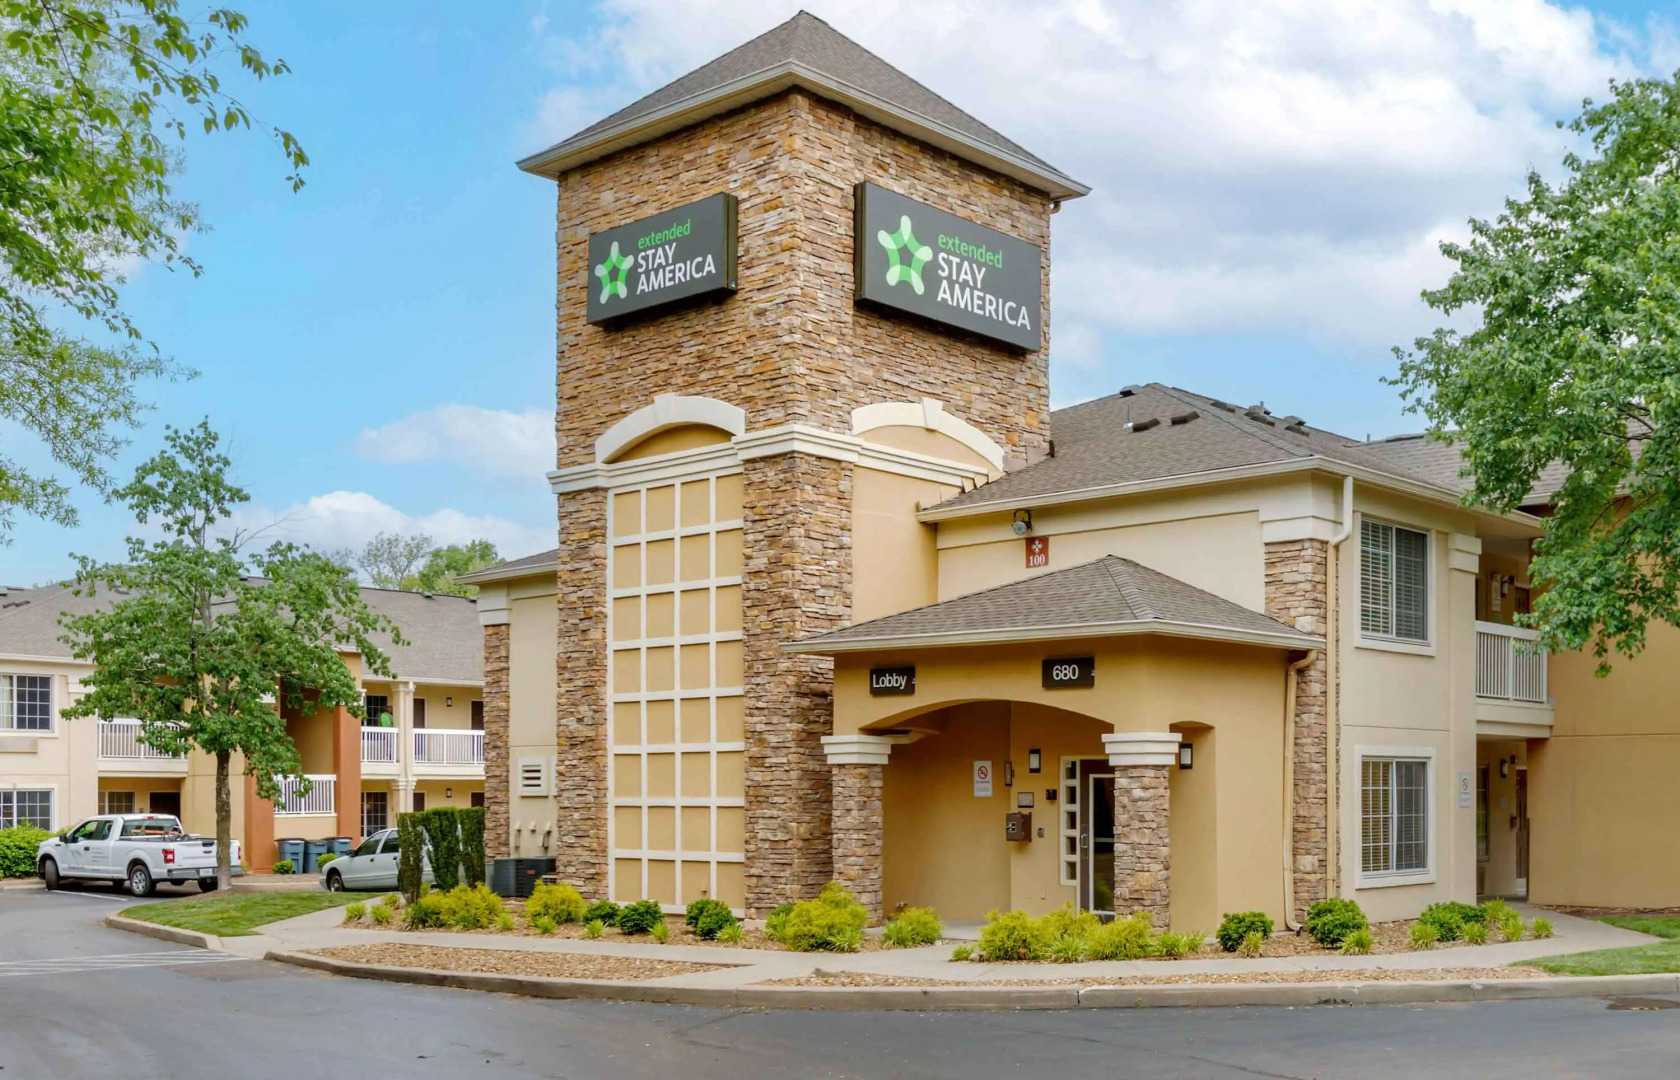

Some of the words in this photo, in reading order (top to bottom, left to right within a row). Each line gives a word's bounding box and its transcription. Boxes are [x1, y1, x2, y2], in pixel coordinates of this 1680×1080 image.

[637, 218, 691, 249] extended
[637, 242, 677, 273] STAY
[937, 233, 1003, 269] extended
[636, 254, 716, 295] AMERICA
[937, 251, 986, 289] STAY
[937, 279, 1031, 331] AMERICA
[1029, 553, 1045, 567] 100
[872, 673, 907, 690] Lobby
[1053, 664, 1079, 680] 680
